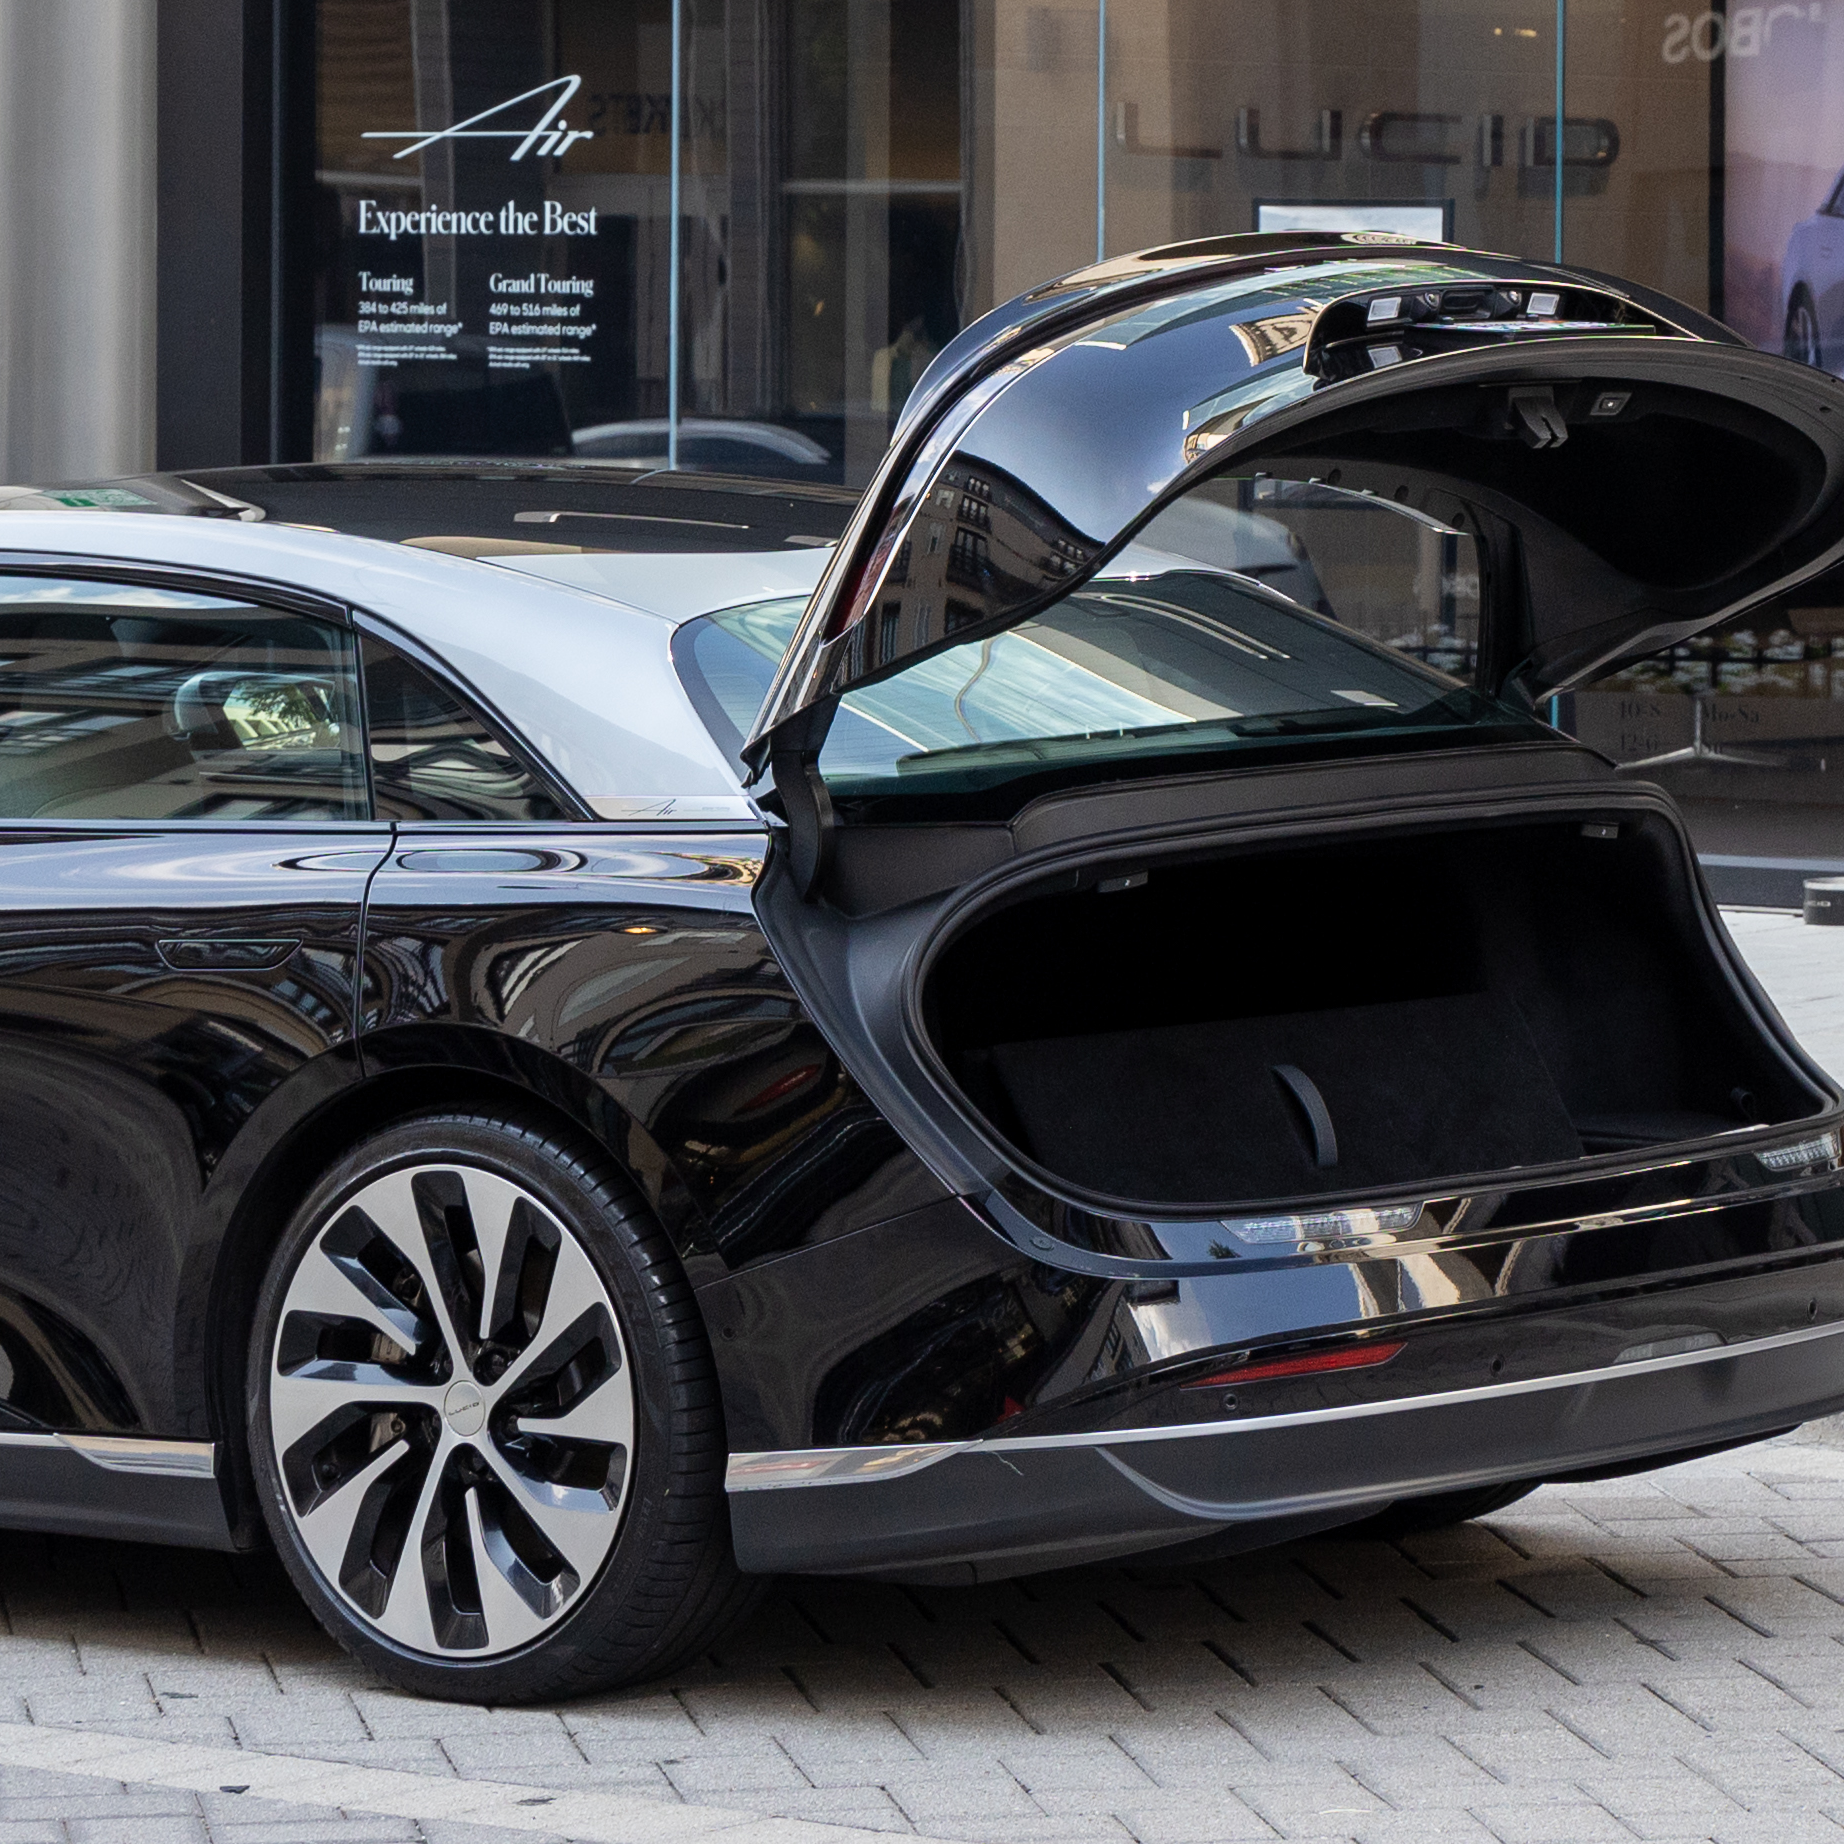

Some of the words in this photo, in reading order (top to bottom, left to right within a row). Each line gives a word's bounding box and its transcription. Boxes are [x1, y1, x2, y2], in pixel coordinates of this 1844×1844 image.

[360, 74, 595, 162] Air
[1114, 101, 1620, 170] LUCID
[358, 199, 494, 241] Experience
[499, 200, 539, 236] the
[543, 200, 598, 236] Best
[358, 271, 414, 296] Touring
[489, 272, 535, 294] Grand
[536, 272, 595, 298] Touring
[378, 302, 389, 315] to
[409, 302, 435, 315] miles
[436, 302, 447, 315] of
[510, 304, 521, 316] to
[542, 303, 568, 316] miles
[569, 304, 581, 317] of
[358, 319, 378, 333] EPA
[379, 320, 428, 334] estimated
[489, 321, 510, 335] EPA
[511, 322, 561, 335] estimated
